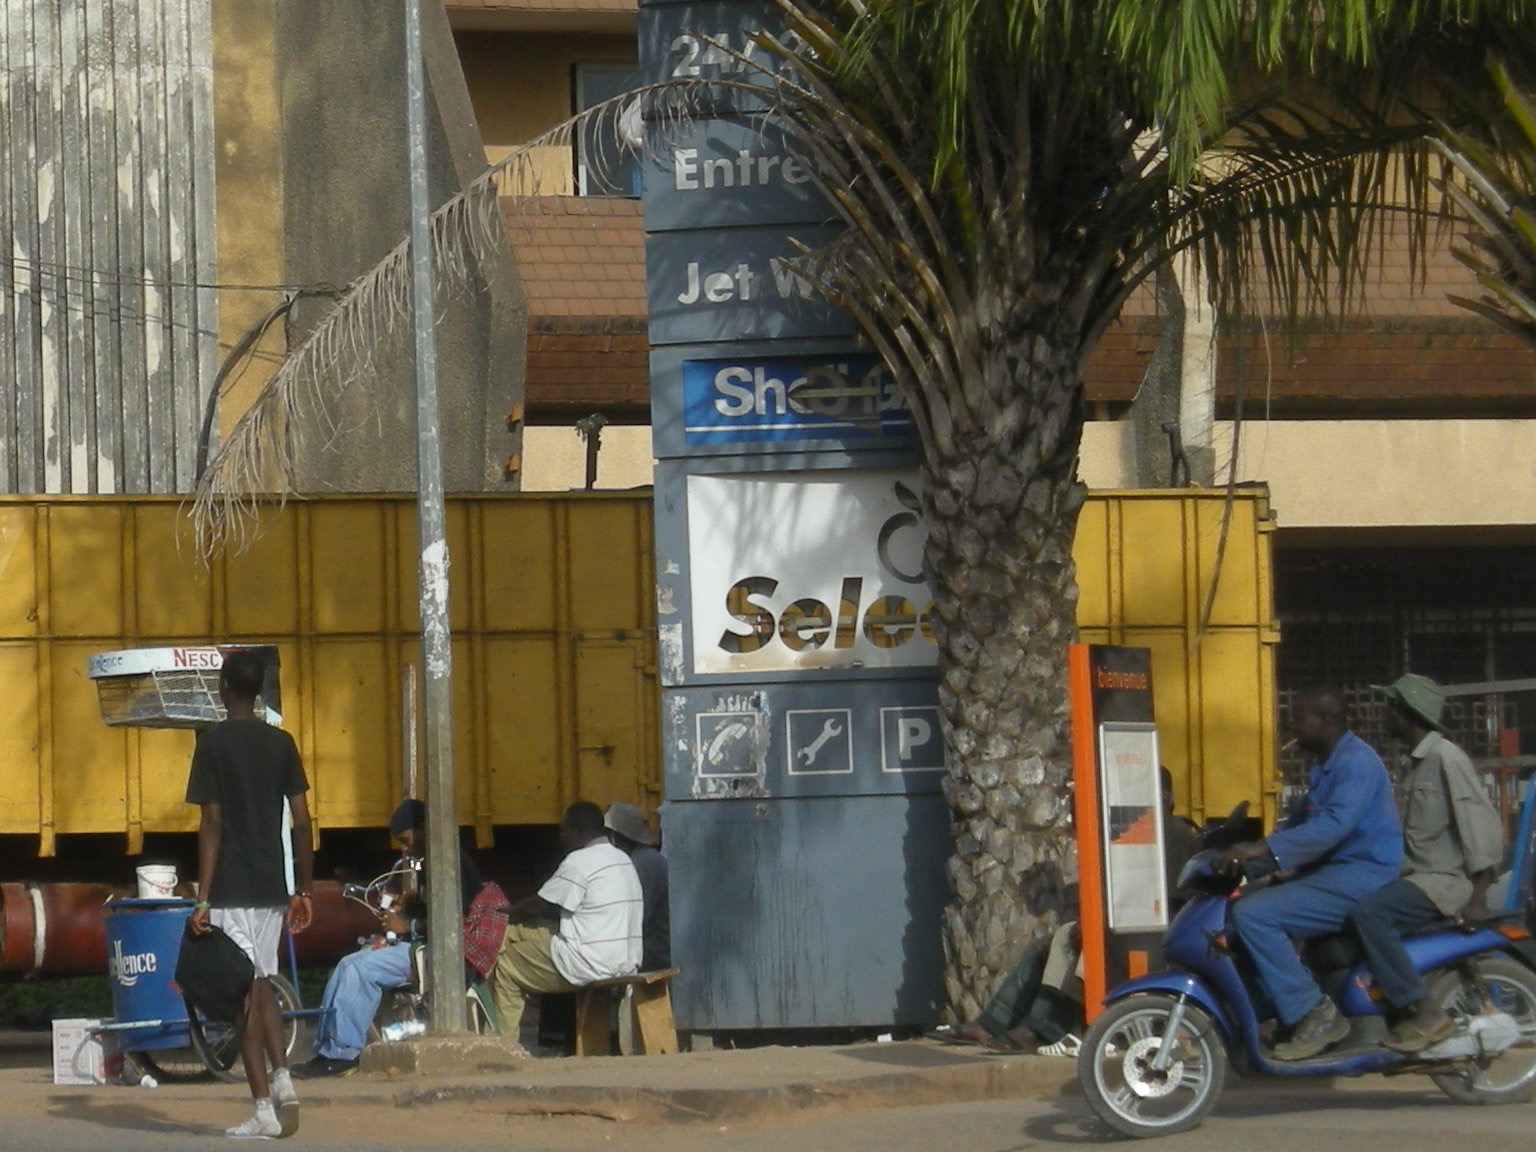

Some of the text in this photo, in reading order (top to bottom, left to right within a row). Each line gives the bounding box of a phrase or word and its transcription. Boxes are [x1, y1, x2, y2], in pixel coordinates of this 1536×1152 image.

[675, 149, 831, 190] Entre
[677, 258, 754, 305] Jet
[174, 649, 219, 667] NESC
[898, 718, 931, 759] P
